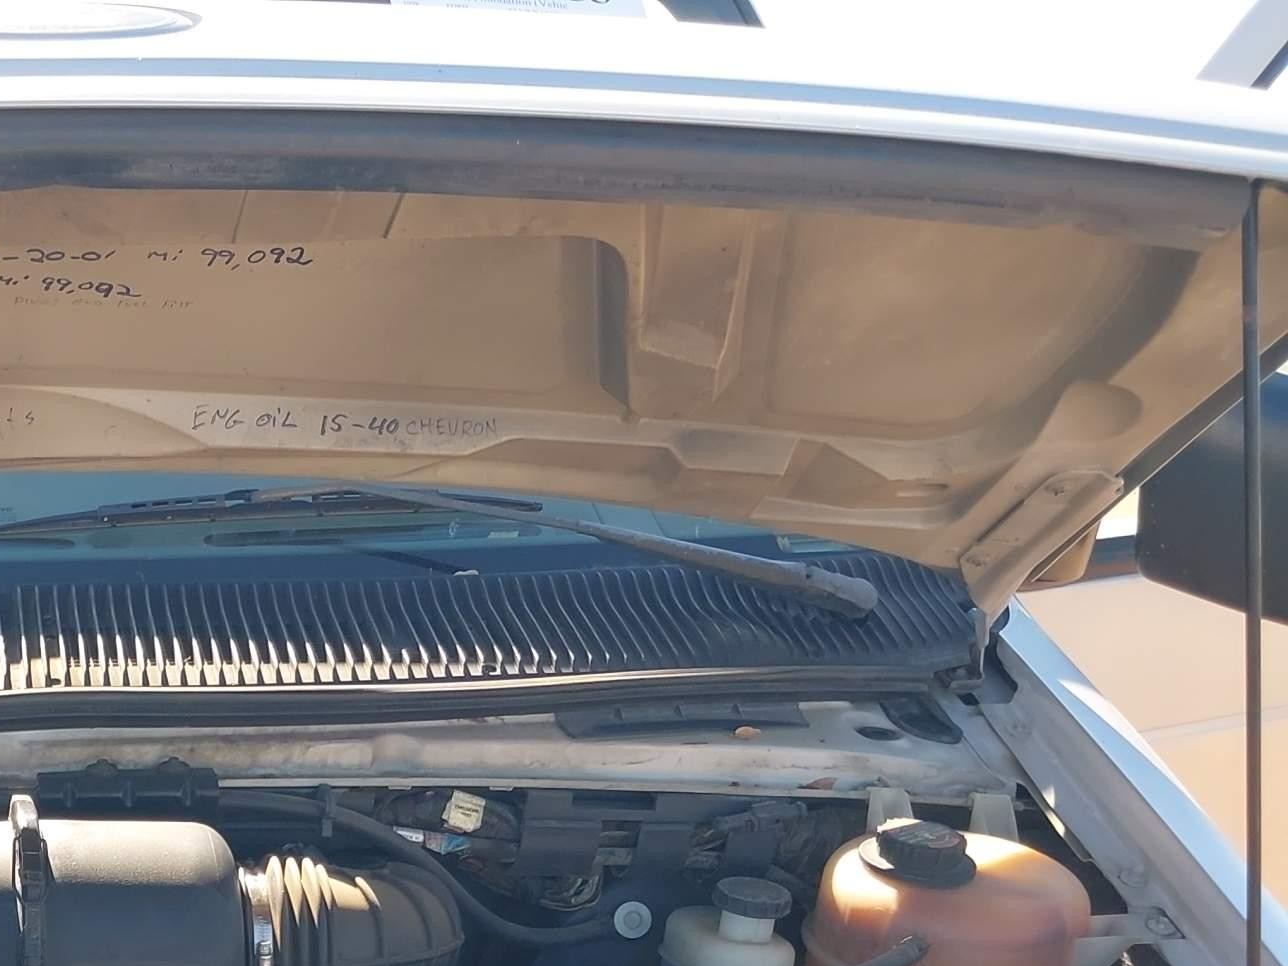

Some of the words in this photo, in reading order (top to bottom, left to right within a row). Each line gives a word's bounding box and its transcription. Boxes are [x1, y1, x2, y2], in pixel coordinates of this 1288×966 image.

[191, 404, 245, 430] ENG
[319, 413, 399, 436] 15-40
[406, 415, 498, 437] CHEVRON
